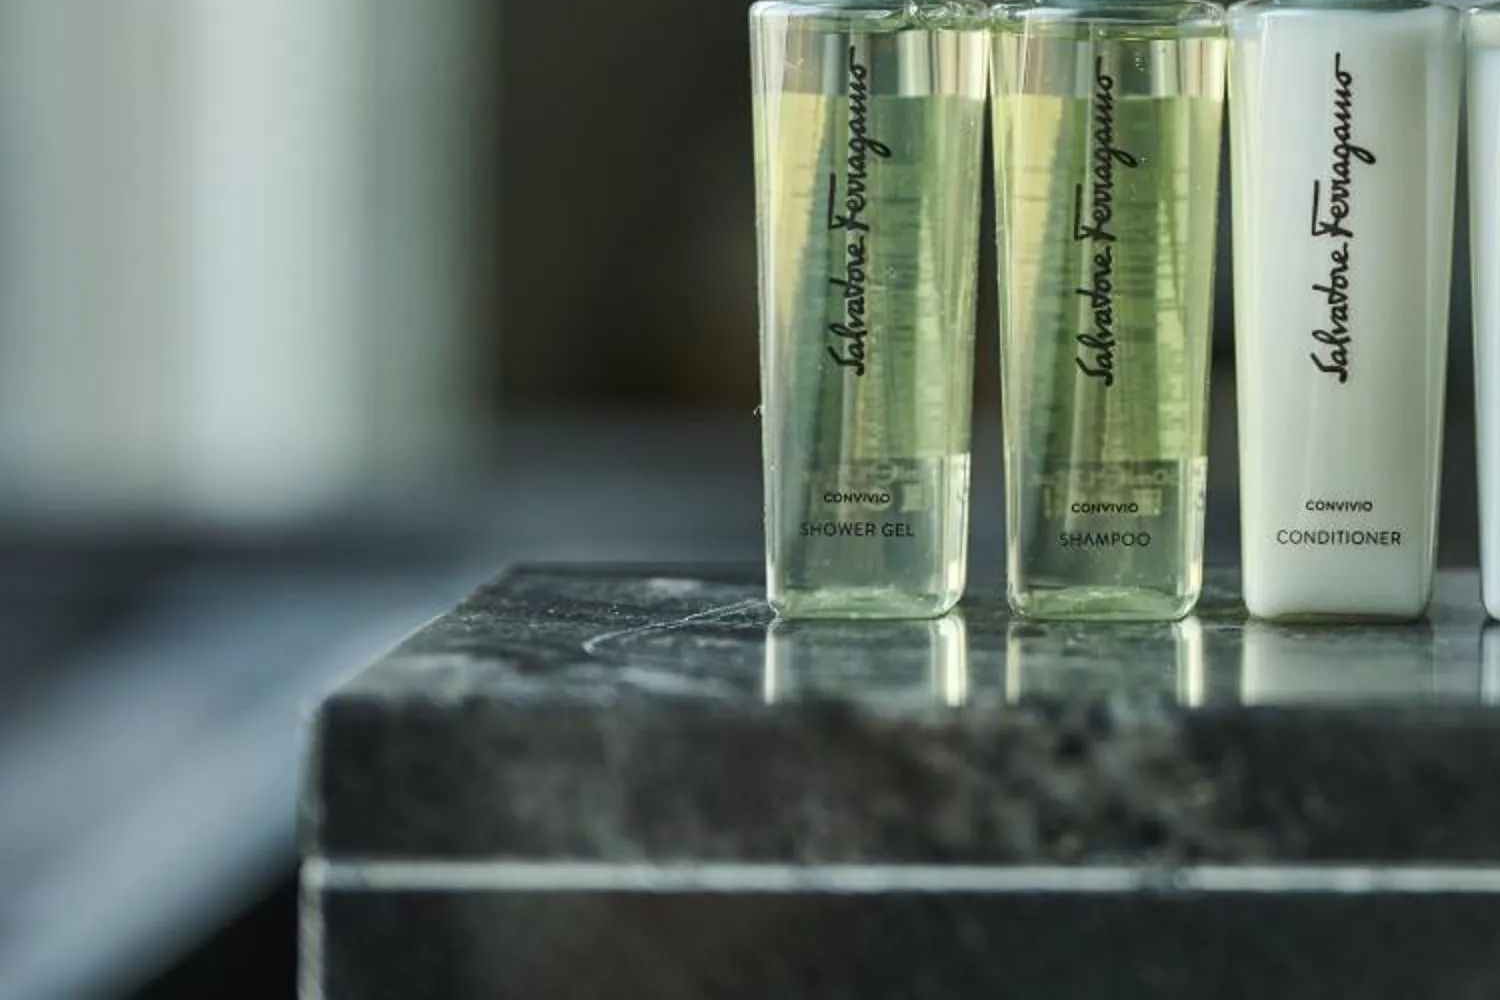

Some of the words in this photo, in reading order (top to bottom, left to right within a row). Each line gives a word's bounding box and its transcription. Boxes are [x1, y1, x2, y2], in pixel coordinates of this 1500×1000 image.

[828, 44, 892, 231] Ferragamo
[1074, 56, 1138, 242] Ferragamo
[1311, 52, 1377, 238] Ferragamo
[826, 236, 867, 376] Salvatore
[1074, 247, 1114, 387] Salvatore
[1310, 242, 1350, 384] Salvatore
[800, 521, 875, 539] SHOWER
[881, 522, 915, 538] GEL
[823, 492, 891, 505] CONVIVIO
[1071, 502, 1139, 514] CONVIVIO
[1276, 529, 1402, 546] CONDITIONER
[1305, 500, 1373, 513] CONVIVIO
[1058, 531, 1152, 548] SHAMPOO
